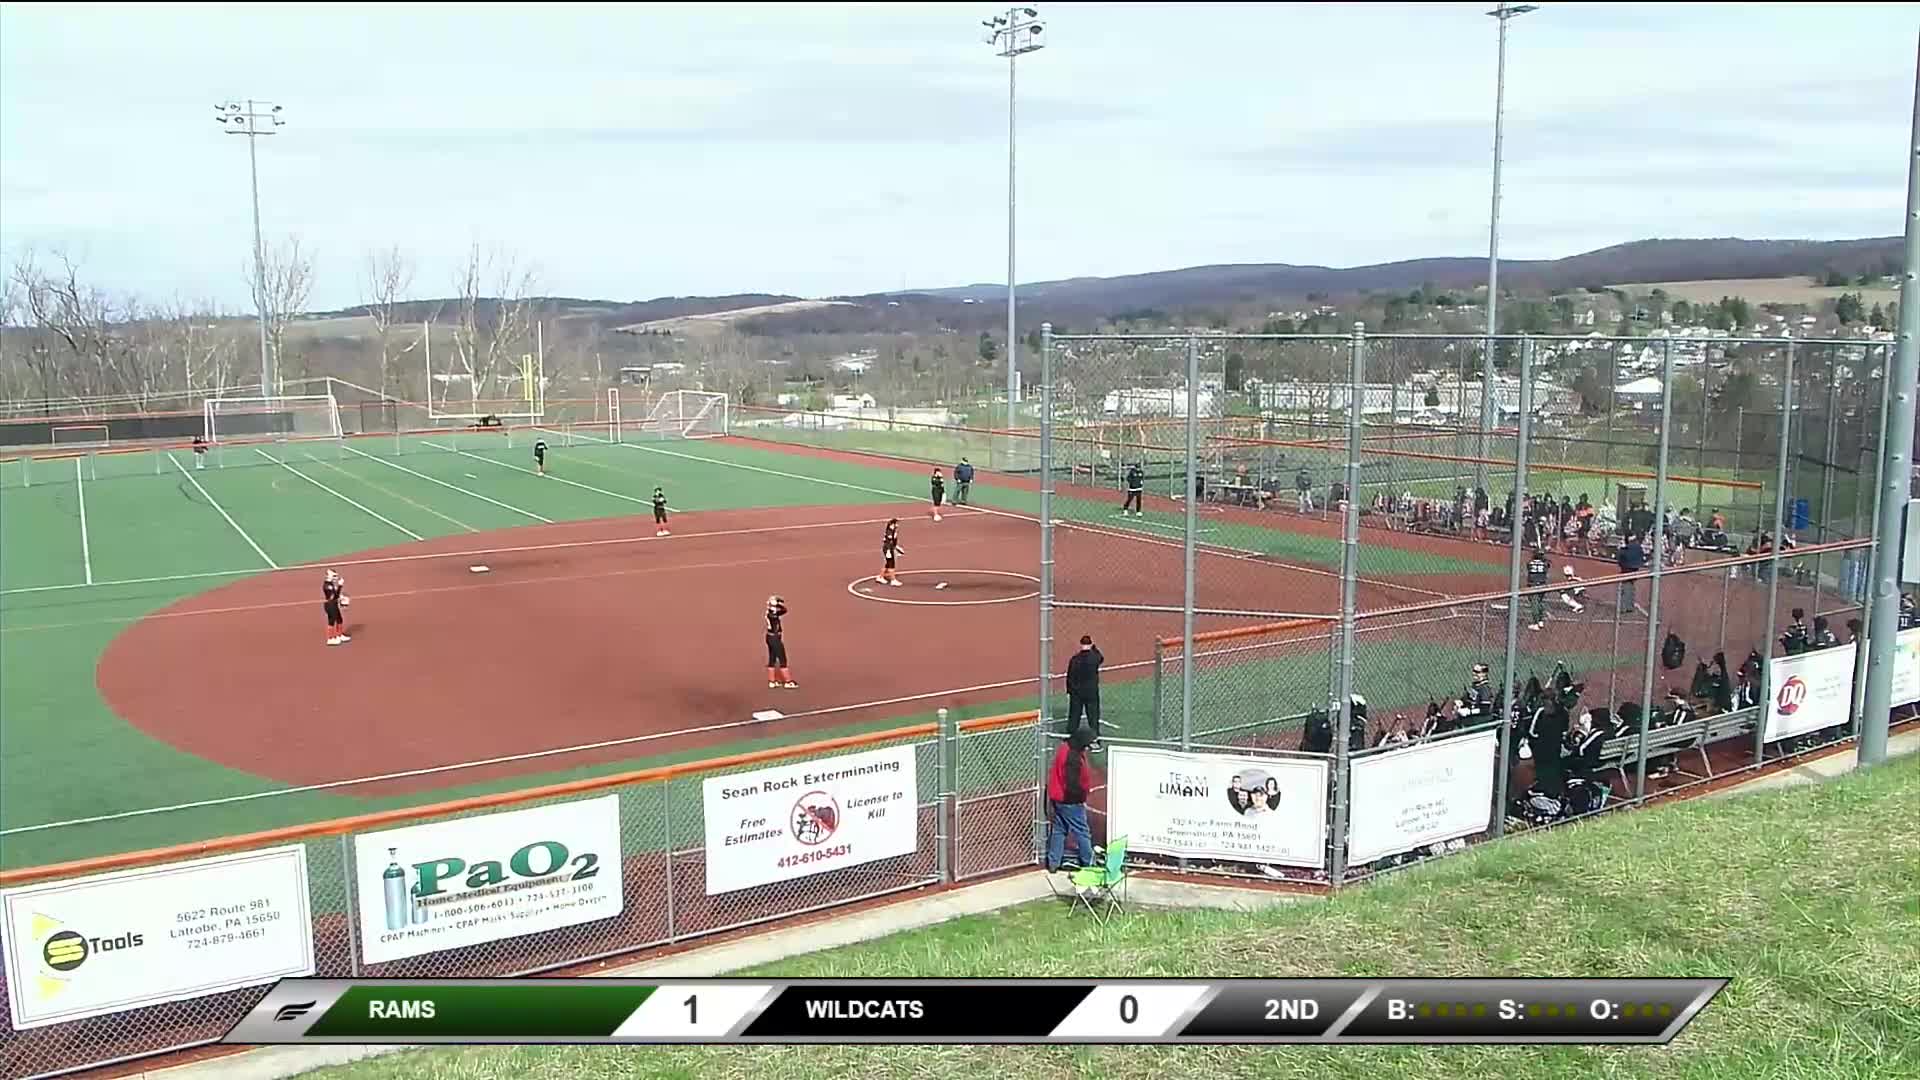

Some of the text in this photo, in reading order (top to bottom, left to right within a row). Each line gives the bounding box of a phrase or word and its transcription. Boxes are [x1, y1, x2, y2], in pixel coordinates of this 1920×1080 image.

[1780, 683, 1804, 708] DQ
[722, 759, 901, 800] Sean Rock Exterminating
[1159, 782, 1210, 798] LIMANI
[847, 791, 903, 809] License to
[740, 816, 767, 829] Free
[867, 808, 886, 820] Kill
[724, 828, 783, 846] Estimates
[1222, 831, 1234, 839] PA
[777, 843, 853, 869] 412-610-5431
[416, 874, 564, 908] Home Medical Equipment
[176, 898, 271, 923] 5622 Route 981
[169, 910, 281, 939] Latrobe, PA 15650
[89, 931, 144, 955] Tools
[186, 928, 266, 949] 724-879-4661
